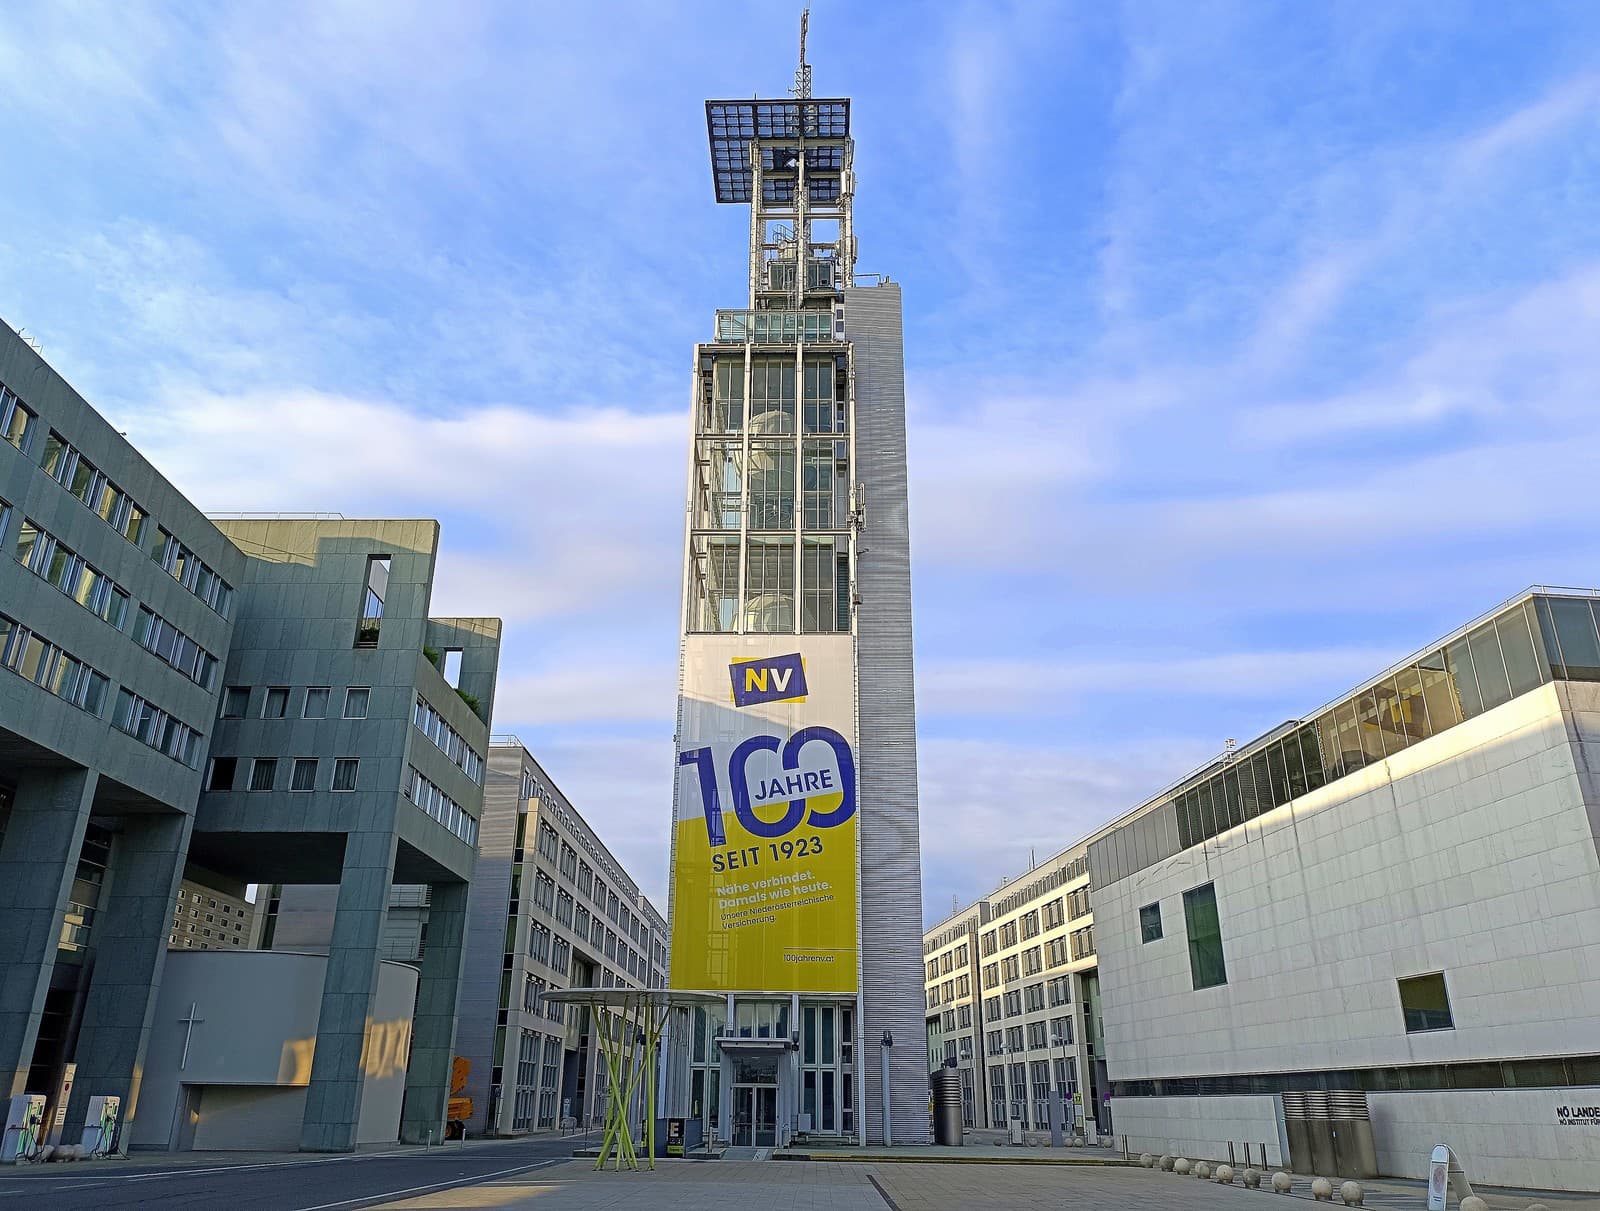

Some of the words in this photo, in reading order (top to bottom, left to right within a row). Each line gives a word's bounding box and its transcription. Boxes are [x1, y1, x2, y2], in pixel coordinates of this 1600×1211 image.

[745, 668, 793, 692] NV
[680, 726, 856, 847] 100
[755, 769, 833, 800] JAHRE
[711, 846, 760, 873] SEIT
[769, 836, 823, 862] 1923
[716, 883, 750, 897] Nähe
[752, 870, 815, 890] verbindet.
[719, 892, 767, 909] Damals
[769, 887, 791, 900] wie
[793, 881, 833, 896] heute.
[721, 910, 748, 921] Unsere
[750, 894, 834, 914] Niederösterreichische
[1556, 1105, 1570, 1118] NÖ
[1571, 1106, 1600, 1118] LANDE
[670, 1122, 679, 1137] E
